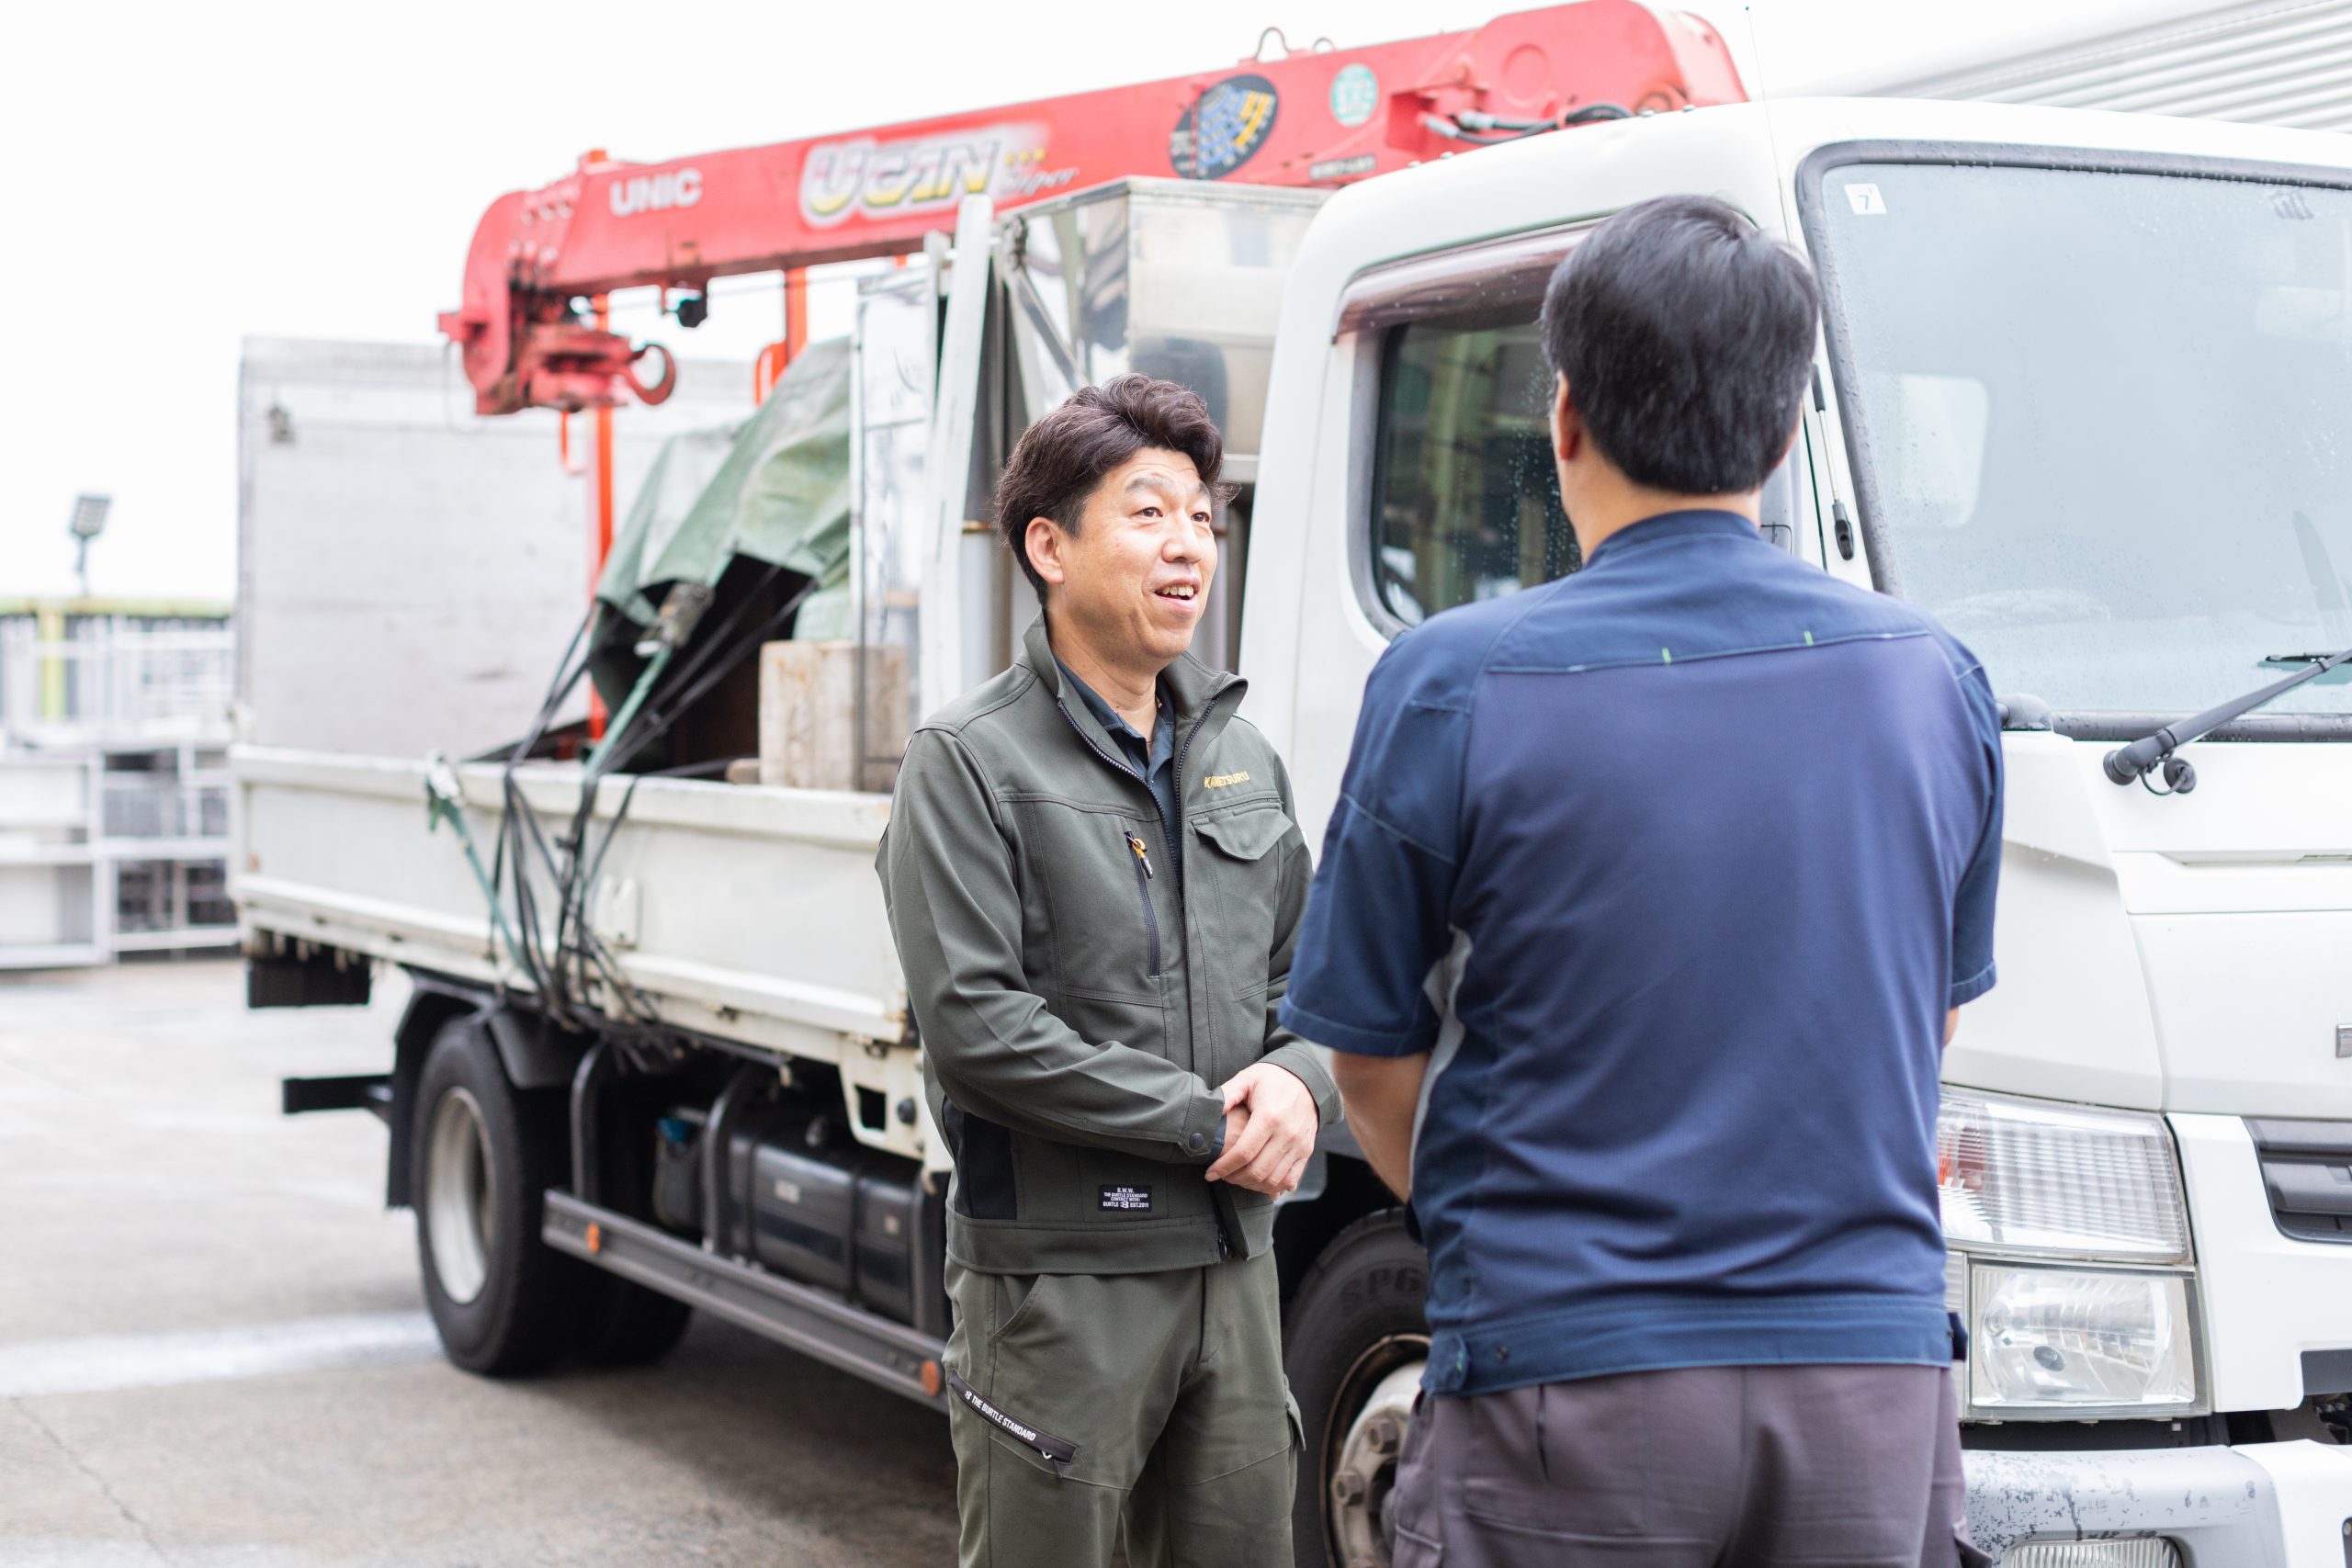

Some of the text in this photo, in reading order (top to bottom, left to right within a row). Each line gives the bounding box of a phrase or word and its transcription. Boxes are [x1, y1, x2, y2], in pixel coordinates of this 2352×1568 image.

[609, 166, 704, 218] UNIC
[971, 1395, 984, 1409] THE
[981, 1403, 1004, 1424] BURTLE
[1002, 1417, 1037, 1441] STANDARD
